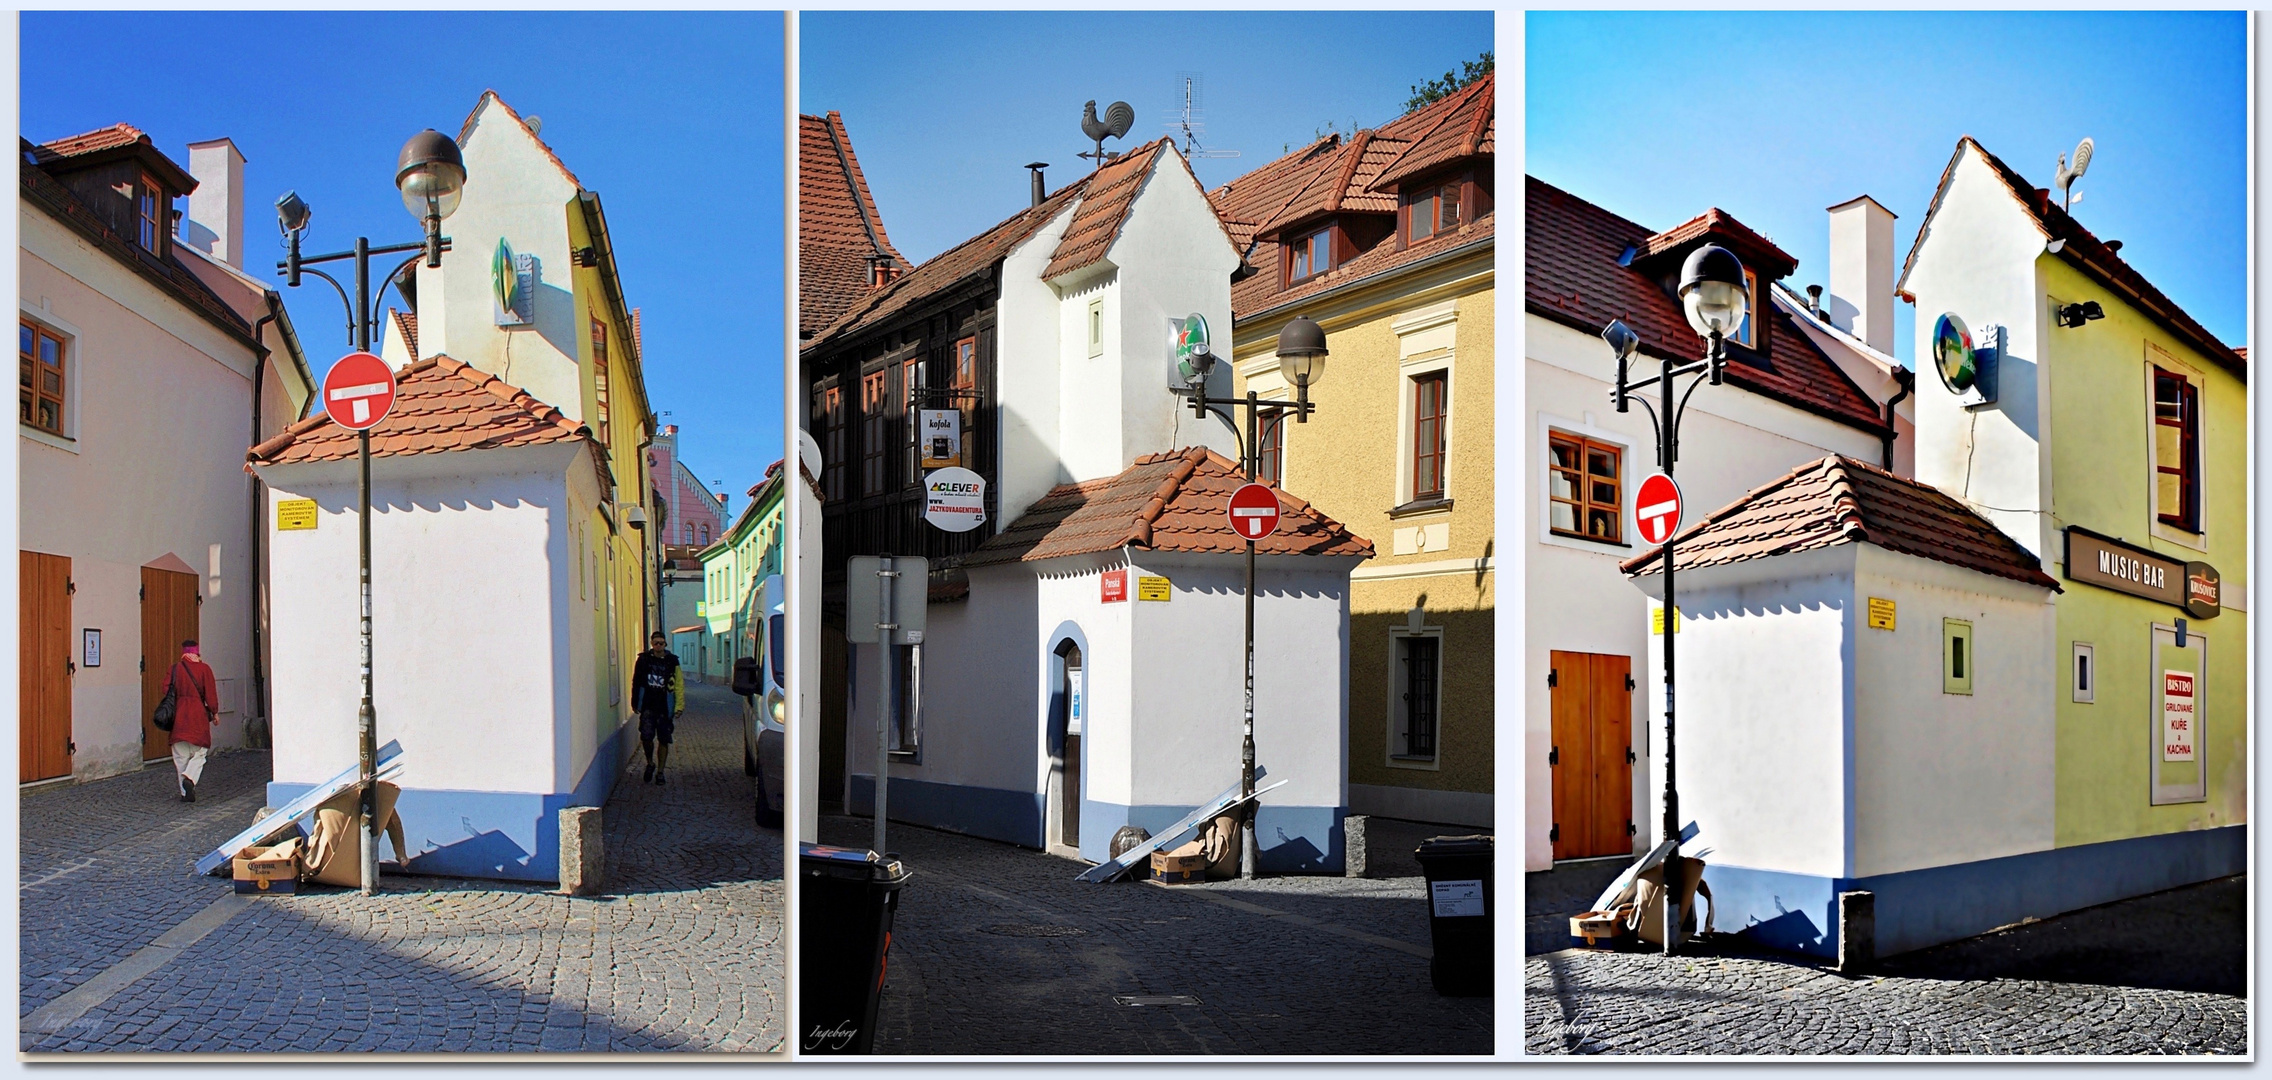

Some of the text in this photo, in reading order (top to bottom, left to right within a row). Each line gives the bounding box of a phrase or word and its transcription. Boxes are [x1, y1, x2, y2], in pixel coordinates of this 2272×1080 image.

[929, 419, 951, 430] kofola
[939, 482, 979, 493] CLEVER
[2098, 549, 2165, 589] MUSIC BAR
[2190, 579, 2217, 599] KRUŠOVICE
[2167, 678, 2192, 693] BISTRO
[2166, 703, 2193, 713] GRILOVANÉ
[2171, 718, 2187, 731] KUŘE
[2167, 744, 2191, 755] KACHNA
[248, 862, 276, 871] Corona
